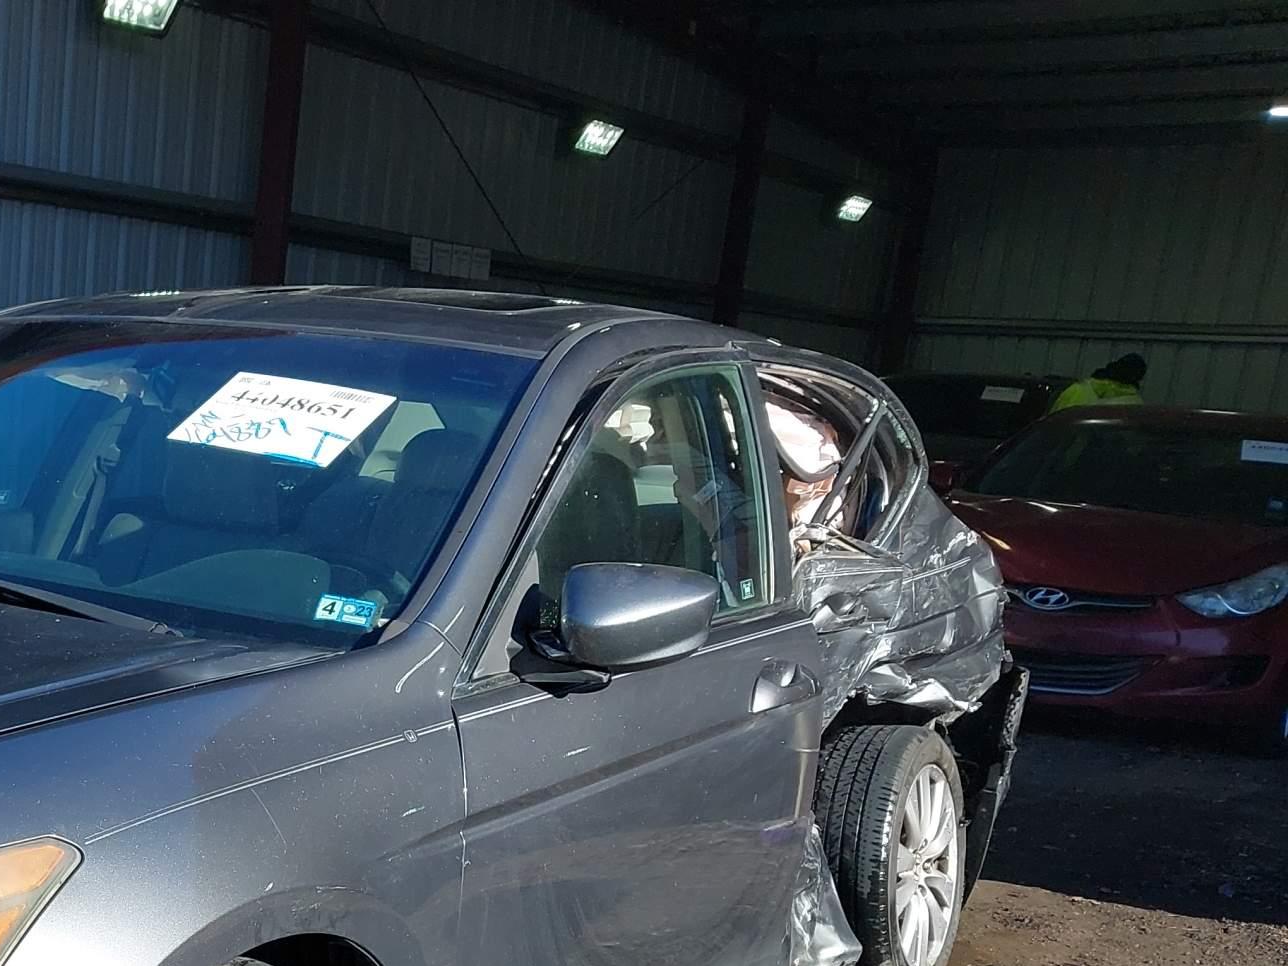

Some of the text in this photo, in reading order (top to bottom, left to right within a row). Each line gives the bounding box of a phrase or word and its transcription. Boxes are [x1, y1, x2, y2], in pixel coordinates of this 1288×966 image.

[231, 389, 357, 419] 44048651
[321, 601, 373, 618] 4 23
